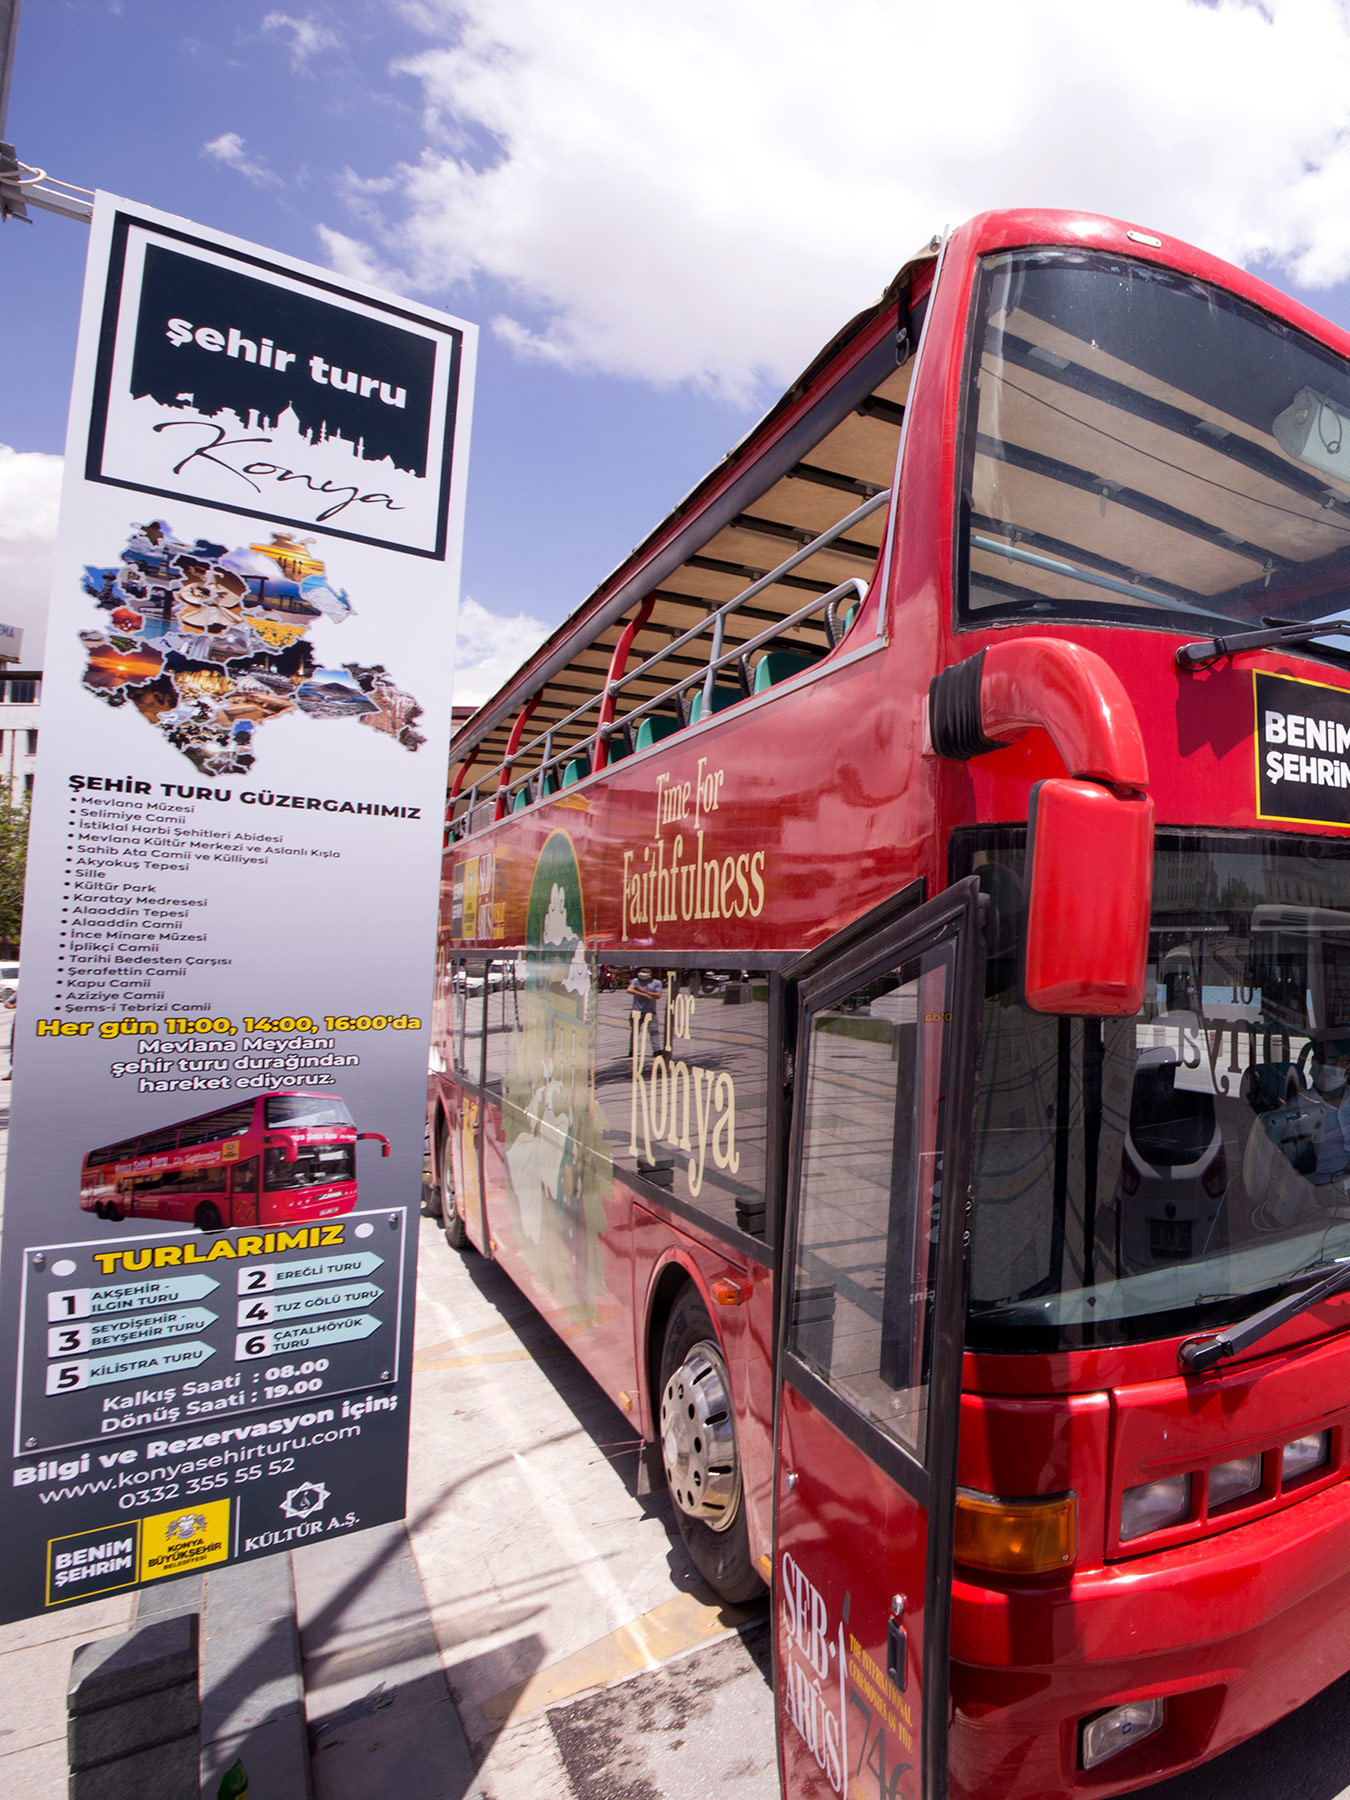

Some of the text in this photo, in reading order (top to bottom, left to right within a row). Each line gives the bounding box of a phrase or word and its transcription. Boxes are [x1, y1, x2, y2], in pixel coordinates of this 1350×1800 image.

[165, 318, 407, 408] şehir turu
[153, 421, 406, 522] Konya
[68, 775, 421, 819] ŞEHİR TURU GÜZERGAHIMIZ
[81, 797, 195, 813] Mevlana Müzesi
[655, 757, 724, 839] Time For
[80, 808, 186, 824] Selimiye Camii
[79, 819, 283, 843] İstiklal Harbi Şehitleri Abidesi
[77, 844, 118, 856] Sahib
[122, 848, 147, 857] Ata
[151, 849, 191, 860] Camii
[214, 854, 269, 866] Külliyesi
[78, 833, 140, 845] Mevlana
[144, 837, 186, 848] Kültür
[190, 841, 243, 852] Merkezi
[265, 845, 308, 856] Aslanlı
[311, 849, 341, 859] Kışla
[75, 869, 106, 879] Sille
[76, 857, 190, 872] Akyokuş Tepesi
[74, 881, 156, 893] Kültür Park
[621, 830, 765, 942] Faithfulness
[73, 893, 208, 907] Karatay Medresesi
[72, 906, 189, 918] Alaaddin Tepesi
[71, 918, 183, 929] Alaaddin Camii
[70, 928, 207, 942] İnce Minare Müzesi
[70, 941, 160, 953] İplikçi Camii
[69, 954, 232, 966] Tarihi Bedesten Çarşısı
[67, 967, 187, 977] Şerafettin Camii
[67, 979, 151, 989] Kapu Camii
[66, 991, 165, 1002] Aziziye Camii
[65, 1003, 212, 1014] Şems-i Tebrizi Camii
[665, 971, 695, 1051] For
[37, 1015, 421, 1039] Her gün 11:00, 14:00, 16:00'da
[138, 1036, 335, 1054] Mevlana Meydanı
[111, 1053, 359, 1078] şehir turu durağından
[138, 1073, 336, 1093] hareket ediyoruz.
[629, 1010, 740, 1197] Konya
[93, 1224, 345, 1275] TURLARIMIZ
[247, 1270, 267, 1290] 2
[276, 1261, 361, 1280] EREĞLİ TURU
[92, 1282, 160, 1300] AKŞEHİR
[275, 1290, 379, 1313] TUZ GÖLÜ TURU
[62, 1295, 76, 1315] 1
[92, 1293, 179, 1313] ILGIN TURU
[245, 1302, 269, 1321] 4
[91, 1313, 177, 1335] SEYDİŞEHİR
[91, 1321, 205, 1346] BEYŞEHİR TURU
[273, 1318, 363, 1340] ÇATALHÖYÜK
[58, 1330, 81, 1351] 3
[245, 1335, 266, 1355] 6
[272, 1338, 310, 1352] TURU
[90, 1350, 203, 1378] KİLİSTRA TURU
[56, 1366, 80, 1389] 5
[102, 1386, 177, 1413] Kalkış
[181, 1372, 242, 1397] Saati
[264, 1358, 330, 1381] 08.00
[101, 1407, 181, 1433] Dönüş
[185, 1390, 245, 1416] Saati
[264, 1378, 323, 1399] 19.00
[13, 1395, 399, 1487] Bilgi ve Rezervasyon için;
[38, 1425, 361, 1504] www.konyasehirturu.com
[118, 1457, 296, 1509] 0332 355 55 52
[244, 1512, 360, 1553] KÜLTÜR A.Ş.
[147, 1542, 222, 1568] BÜYÜKŞEHİR
[167, 1538, 204, 1553] KONYA
